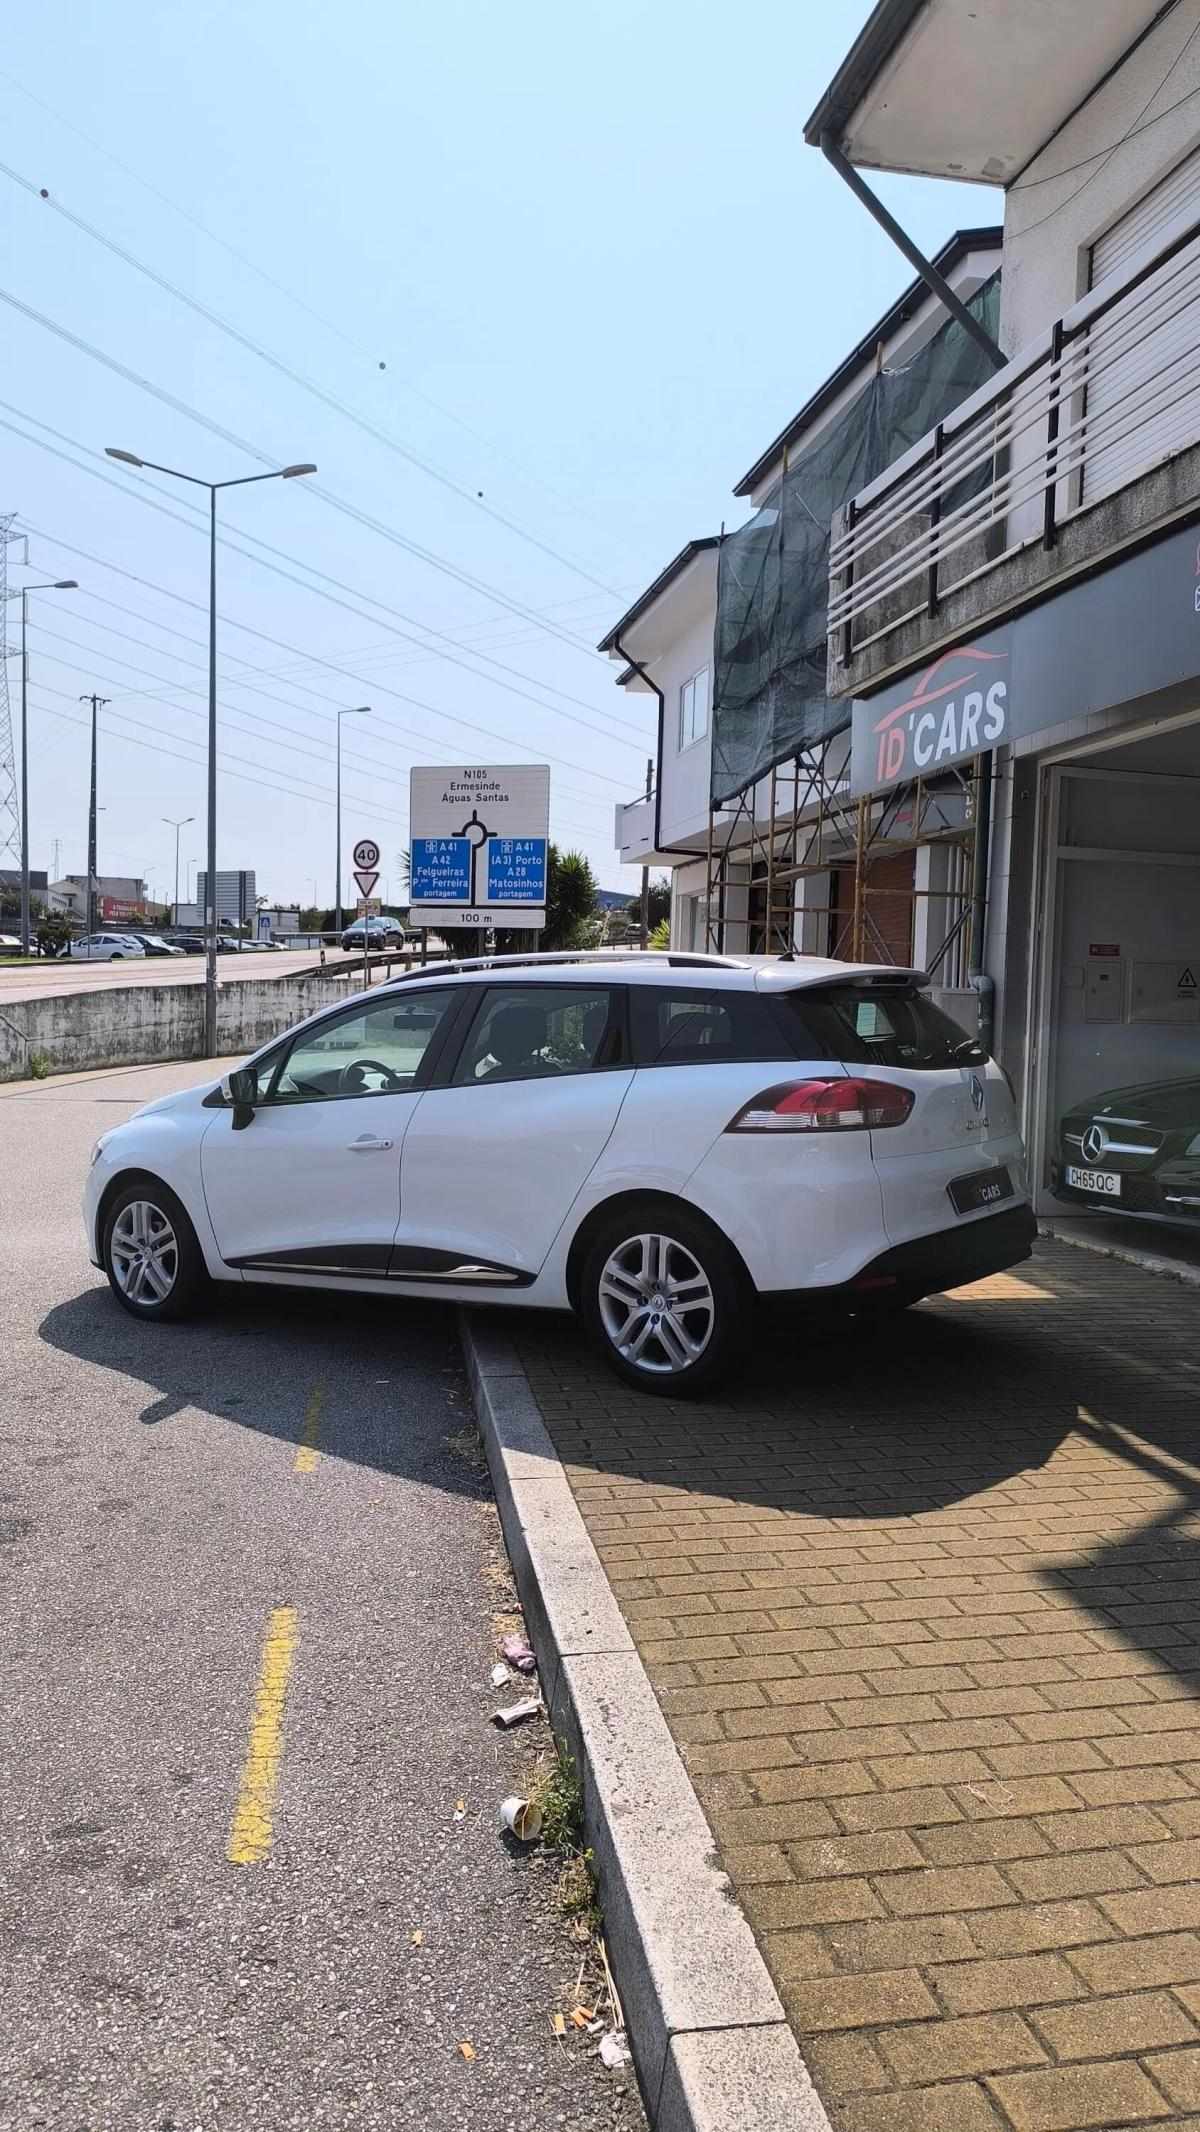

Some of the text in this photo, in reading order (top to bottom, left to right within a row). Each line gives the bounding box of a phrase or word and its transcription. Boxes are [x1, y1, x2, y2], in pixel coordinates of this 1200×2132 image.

[464, 769, 488, 779] N105
[450, 781, 501, 791] Ermesinde
[475, 792, 509, 802] Santas
[358, 848, 376, 861] 40
[515, 855, 543, 865] Porto
[417, 866, 464, 878] Felgueiras
[434, 877, 469, 888] Ferreira
[489, 878, 544, 889] Matosinhos
[423, 890, 457, 898] portagem
[498, 891, 533, 899] portagem
[461, 913, 493, 923] 100 m
